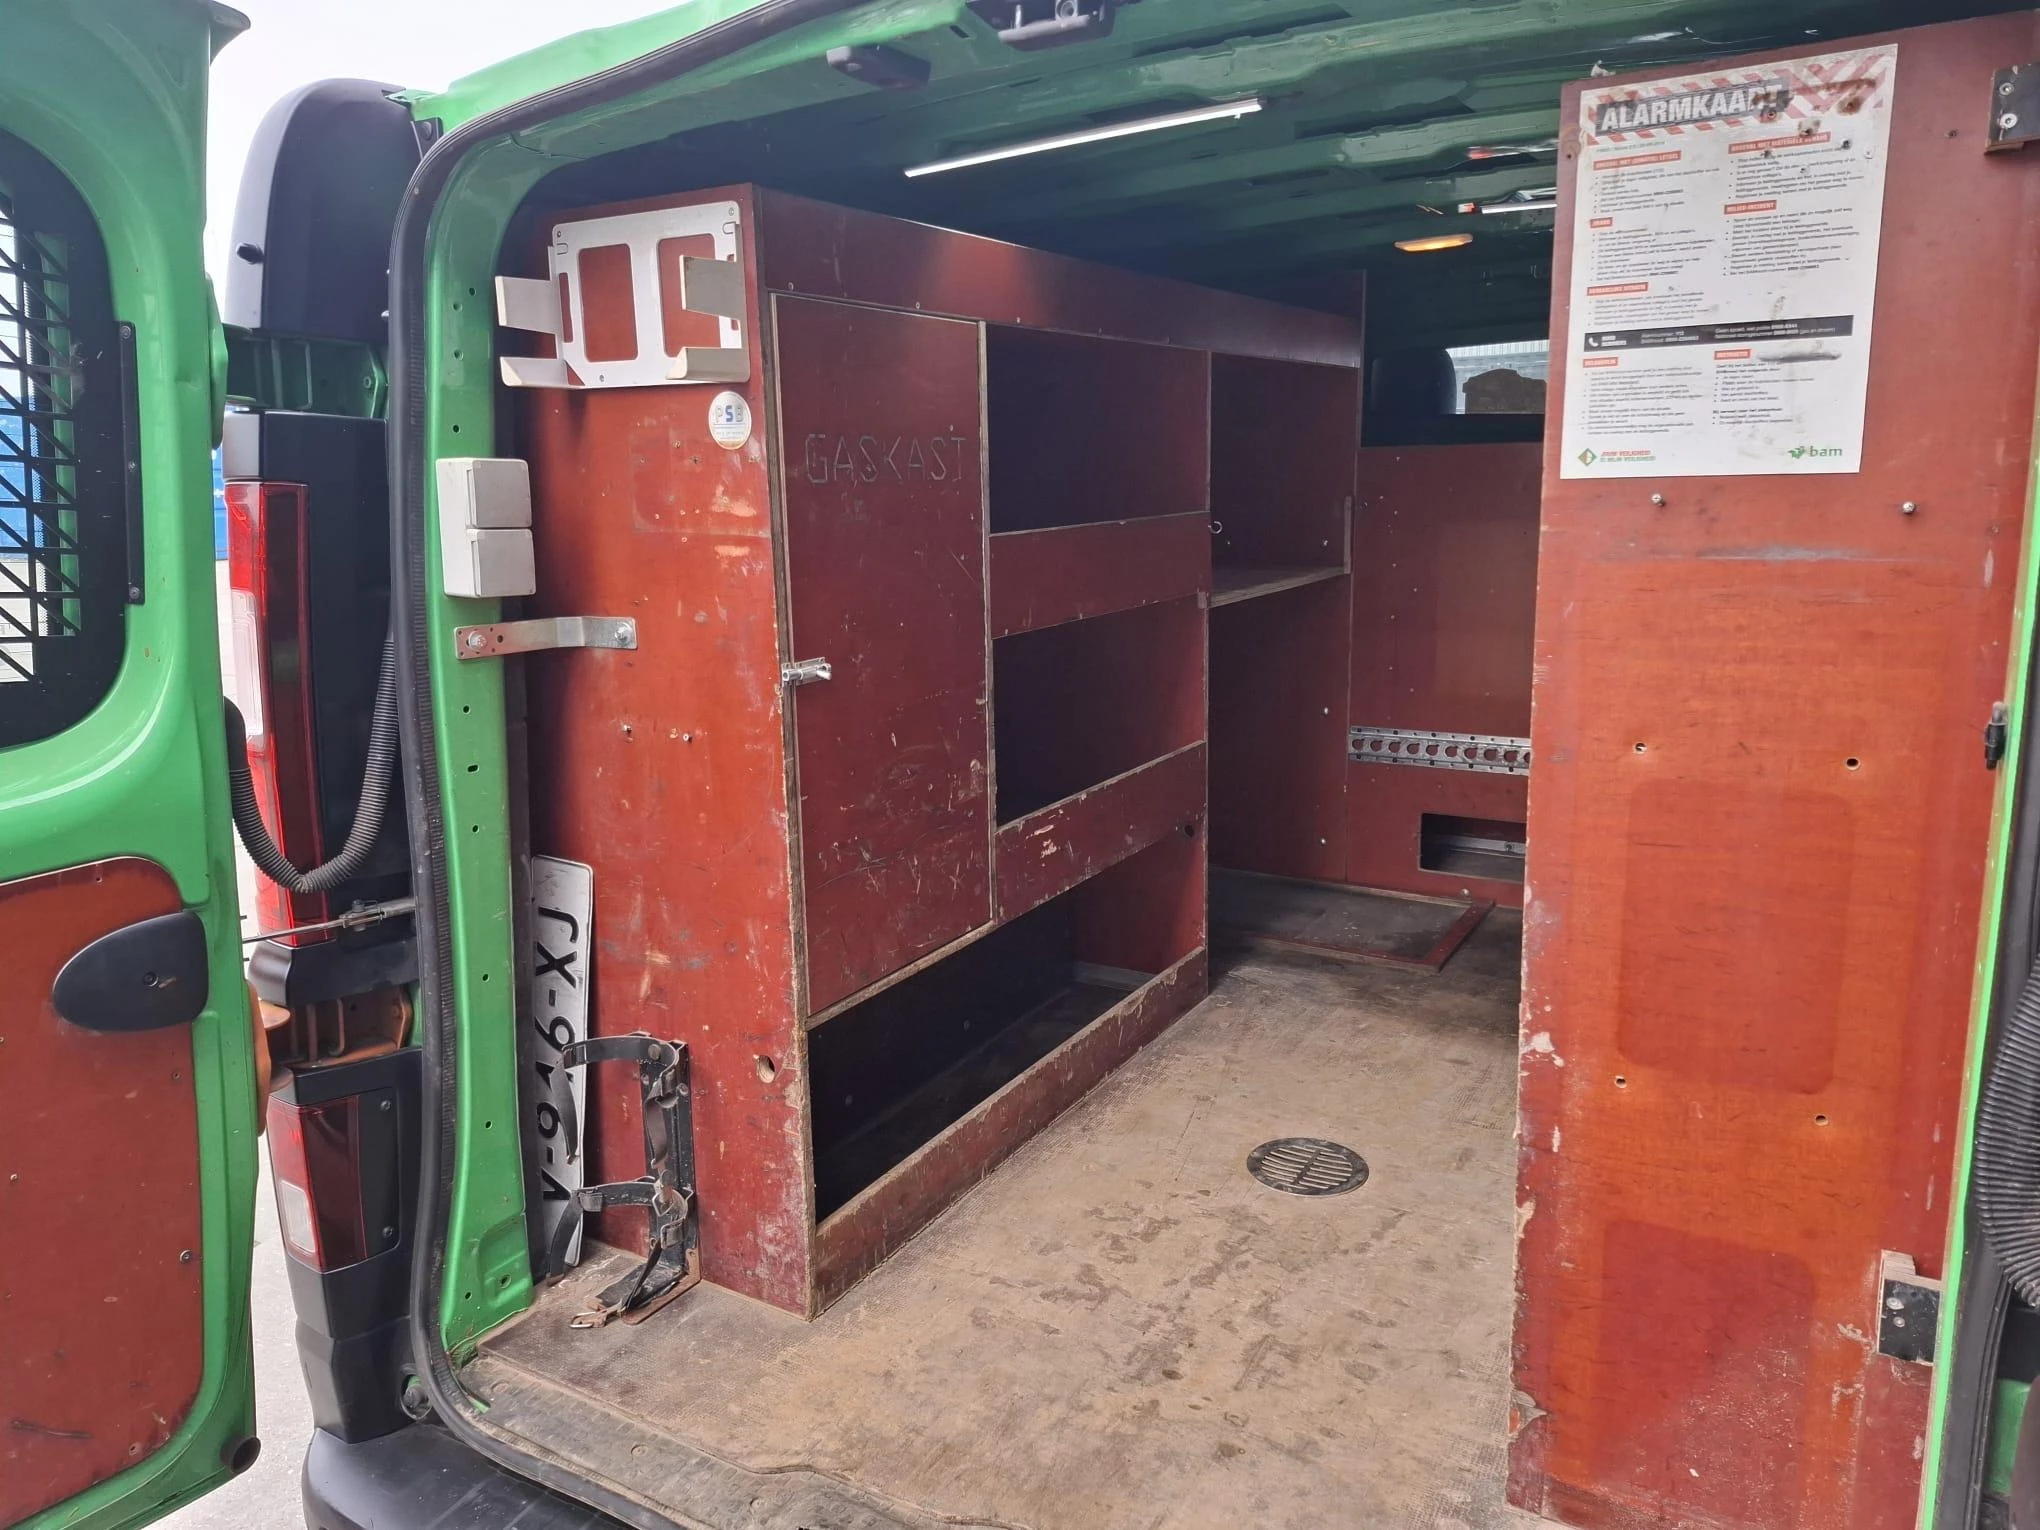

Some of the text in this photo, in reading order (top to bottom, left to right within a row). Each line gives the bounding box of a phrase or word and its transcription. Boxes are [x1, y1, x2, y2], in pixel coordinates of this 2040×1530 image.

[714, 404, 744, 424] PSB
[804, 433, 967, 484] GASKAST
[1808, 445, 1844, 458] bam
